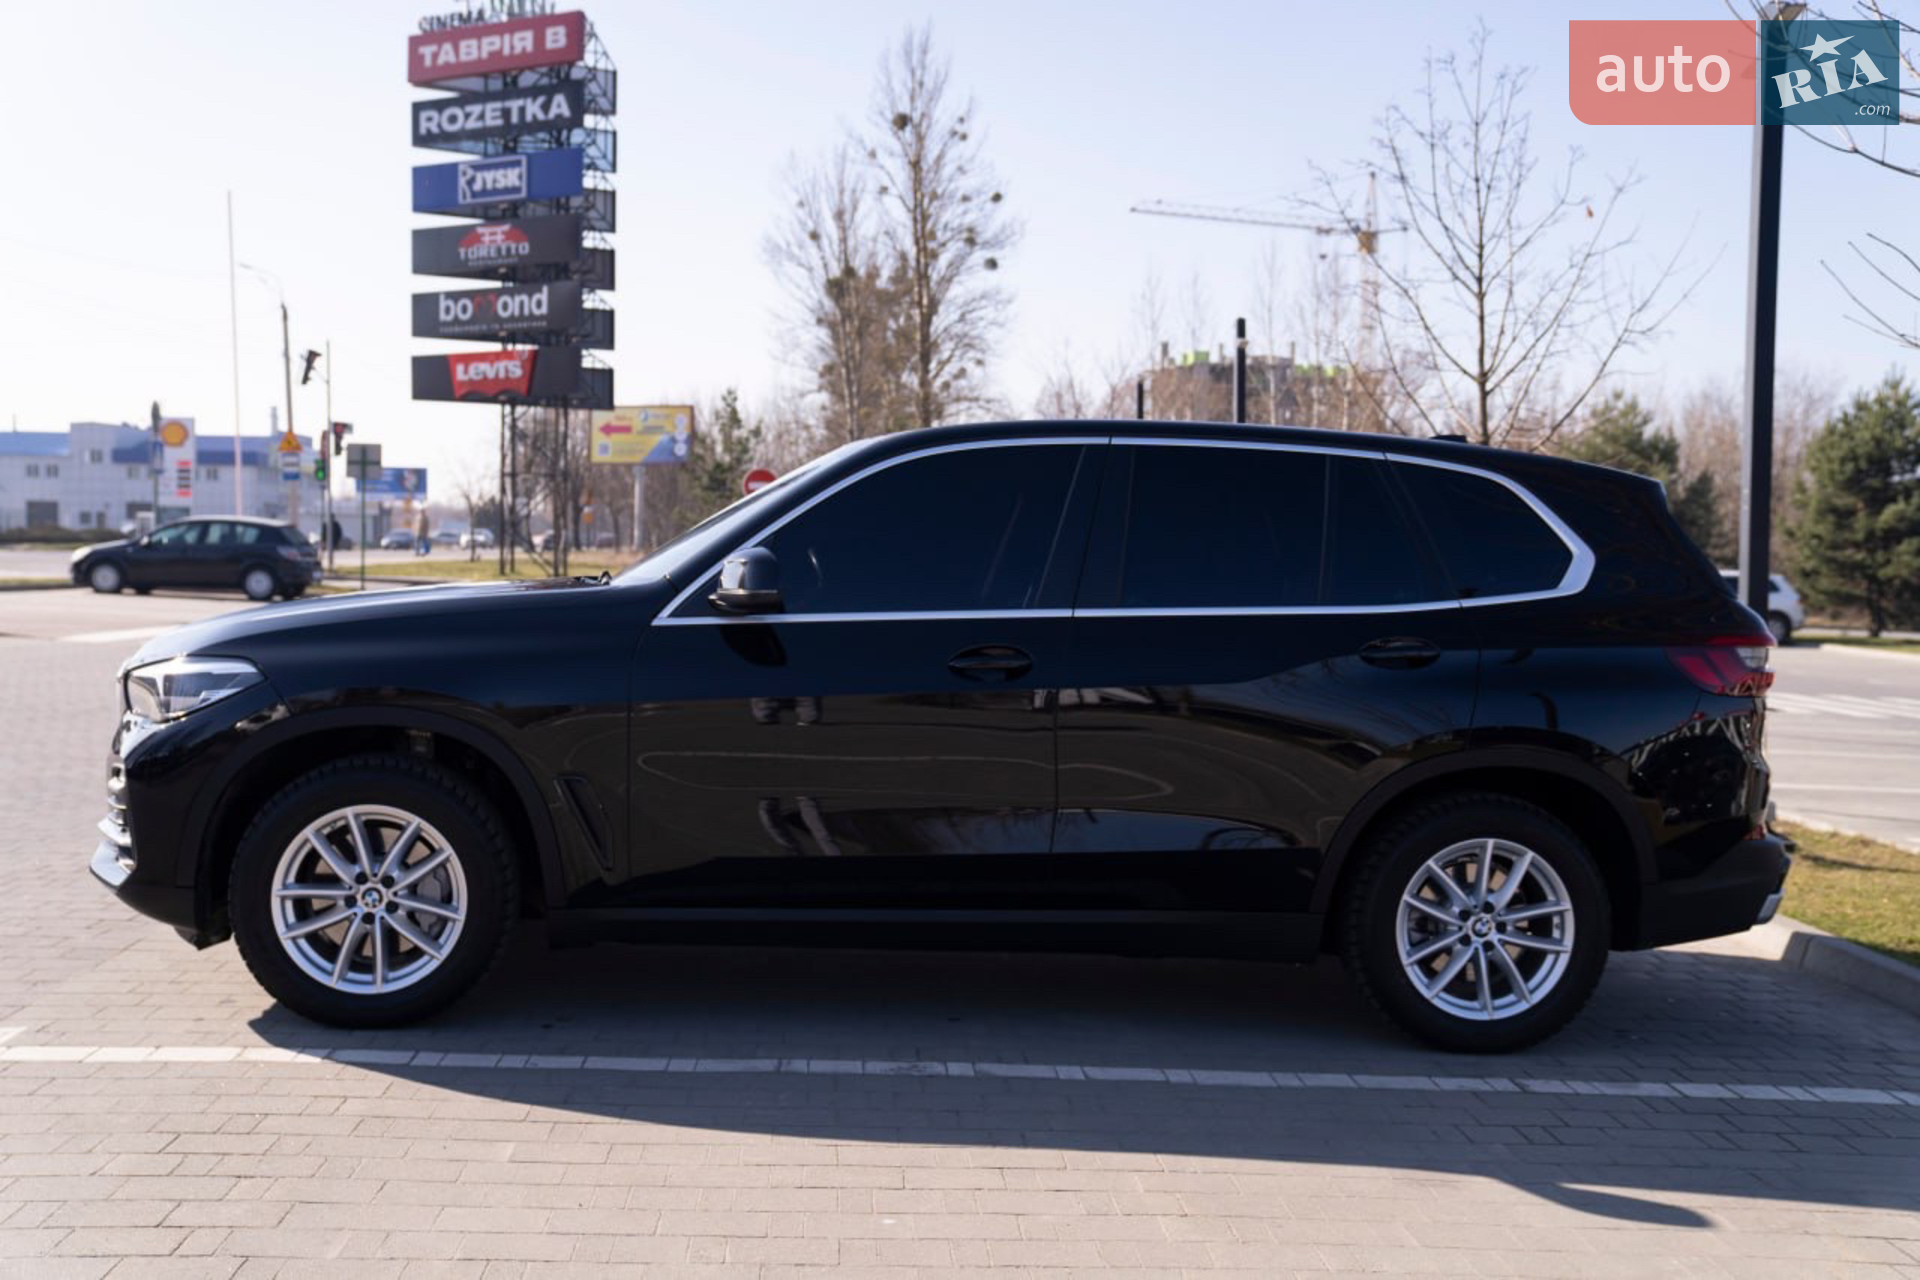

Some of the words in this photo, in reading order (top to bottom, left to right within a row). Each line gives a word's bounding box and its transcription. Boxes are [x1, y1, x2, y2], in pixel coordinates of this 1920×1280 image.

[418, 29, 534, 68] ТАВРІЯ
[544, 25, 567, 49] В
[418, 94, 571, 135] ROZETKA
[472, 167, 521, 192] JYSK
[458, 242, 530, 261] TORETTO
